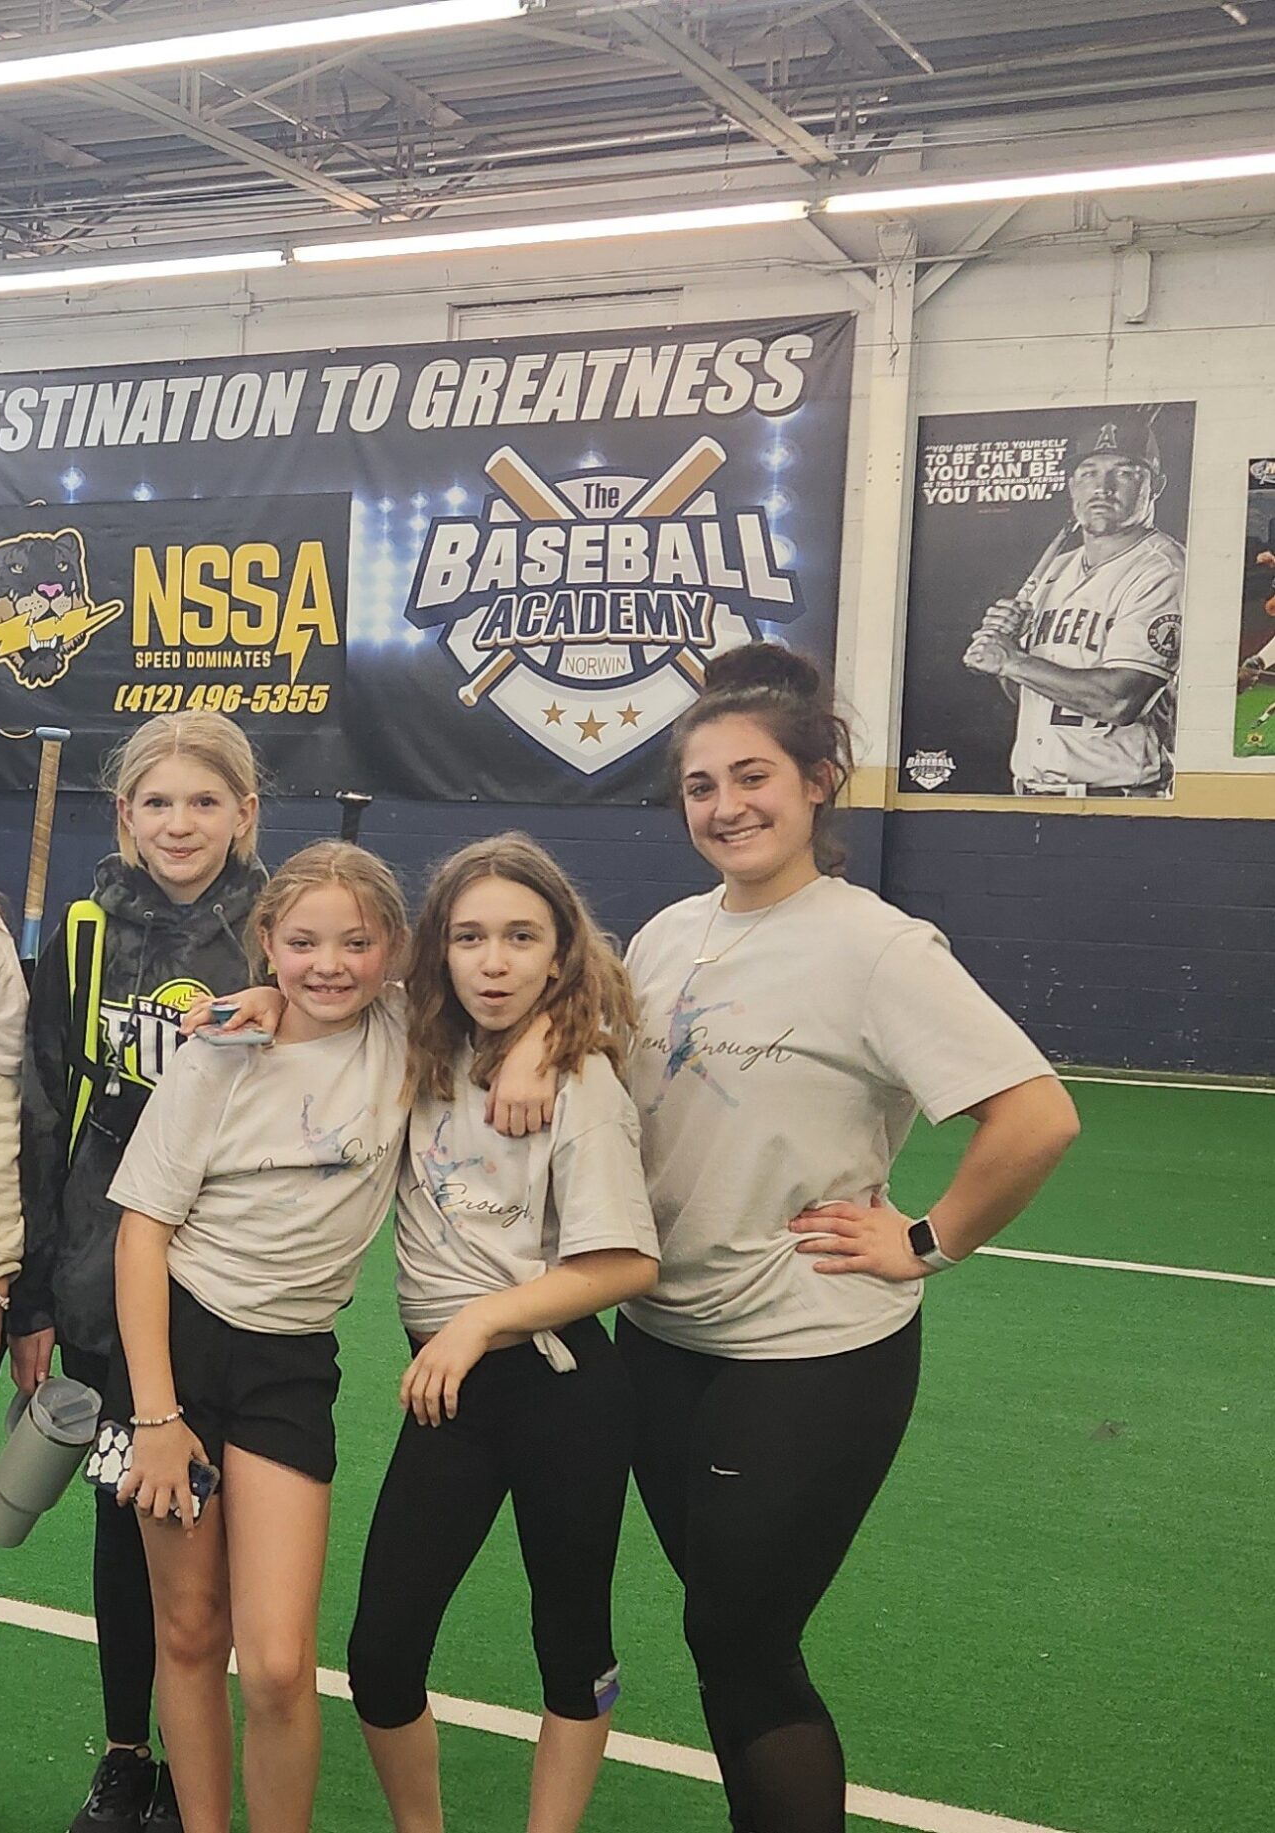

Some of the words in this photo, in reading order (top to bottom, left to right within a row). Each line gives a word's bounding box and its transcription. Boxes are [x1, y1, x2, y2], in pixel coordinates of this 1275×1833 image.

[317, 362, 401, 433] TO
[407, 333, 814, 431] GREATNESS
[925, 453, 947, 466] TO
[952, 452, 975, 465] BE
[980, 449, 1015, 463] THE
[1020, 447, 1067, 462] BEST
[955, 442, 978, 452] OWE
[981, 442, 992, 450] IT
[994, 441, 1009, 450] TO
[1012, 438, 1068, 449] YOURSELF
[925, 465, 969, 482] YOU
[976, 462, 1022, 479] CAN
[1029, 460, 1066, 477] BE.
[583, 482, 620, 509] The
[923, 486, 970, 505] YOU
[416, 512, 794, 609] BASEBALL
[132, 541, 339, 685] NSSA
[477, 589, 713, 647] ACADEMY
[1019, 607, 1115, 654] NGEL
[135, 652, 182, 669] SPEED
[186, 650, 272, 669] DOMINATES
[565, 655, 627, 676] NORWIN
[113, 684, 184, 712] (412)
[186, 684, 331, 714] 496-5355
[138, 1001, 179, 1020] RIV
[677, 1026, 794, 1071] Enough
